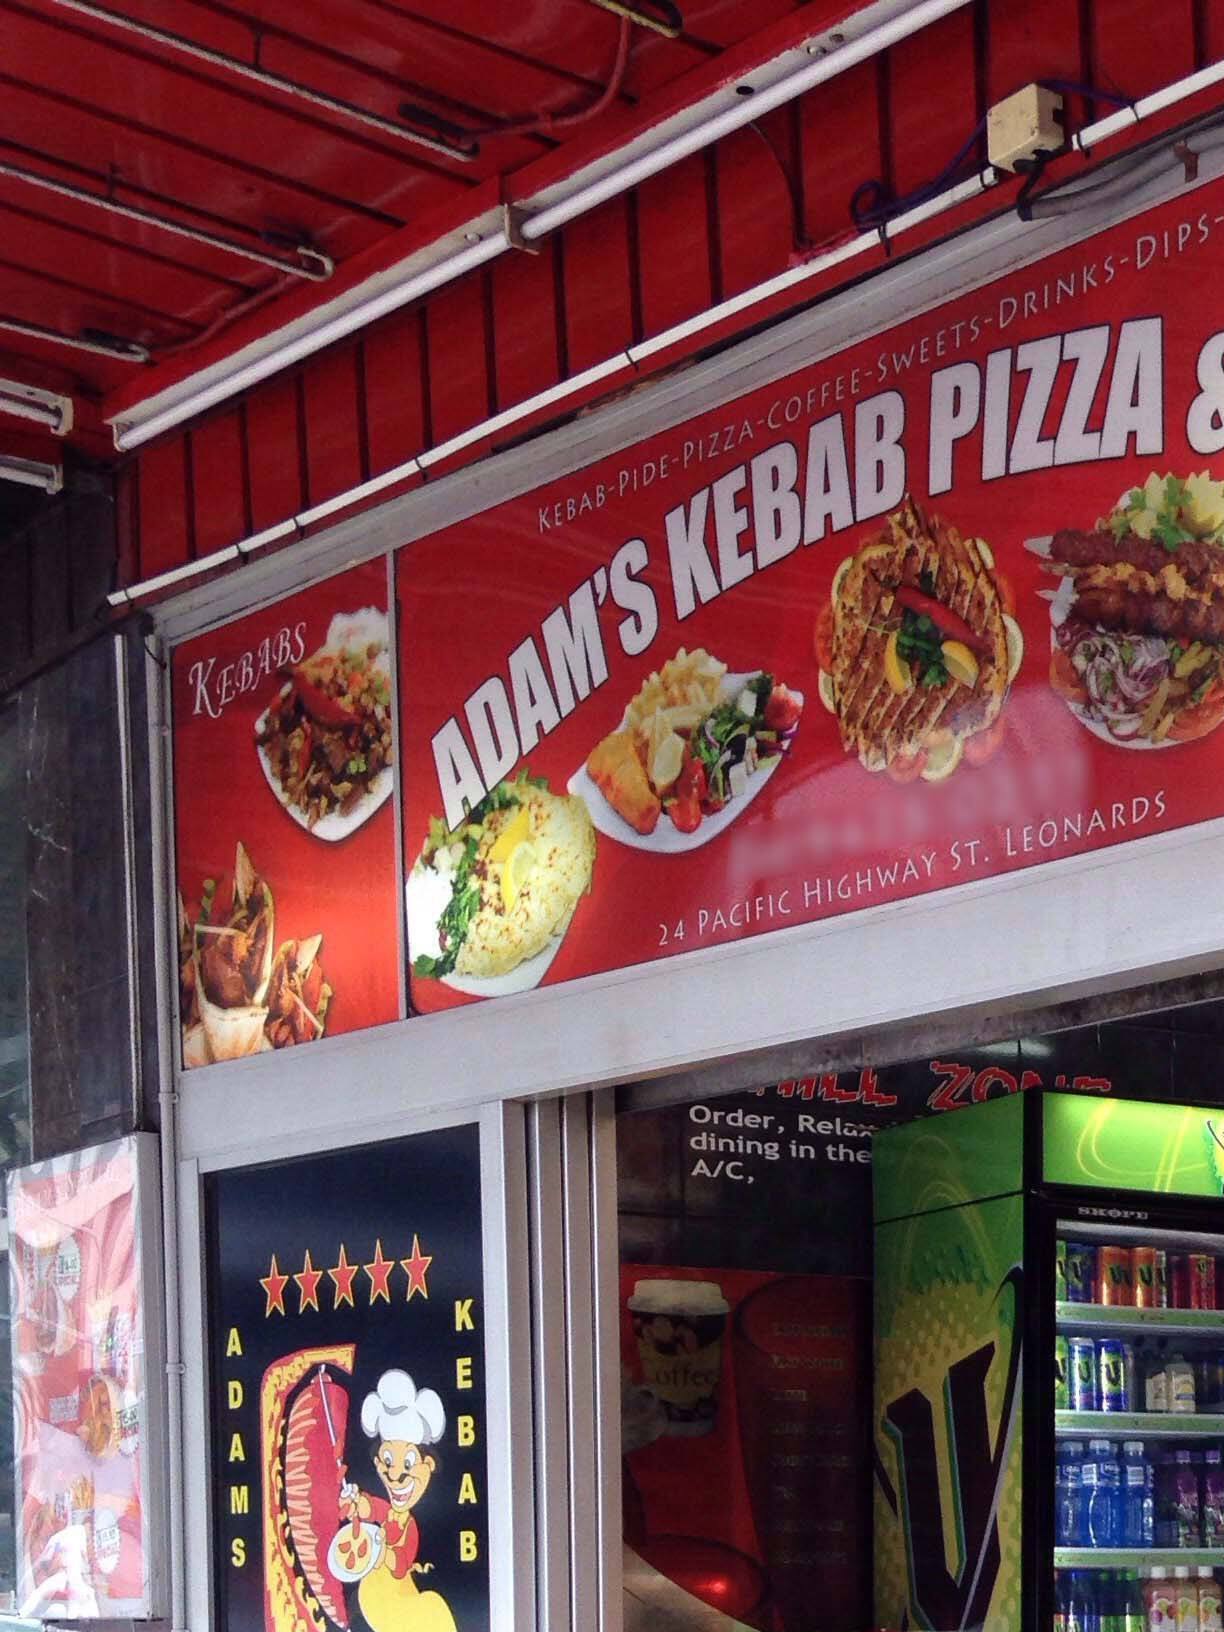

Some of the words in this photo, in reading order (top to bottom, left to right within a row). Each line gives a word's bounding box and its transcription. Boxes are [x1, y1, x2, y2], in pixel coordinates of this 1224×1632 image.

[430, 538, 659, 833] ADAM'S
[663, 388, 907, 620] KEBAB
[927, 315, 1165, 497] PIZZA
[188, 622, 306, 718] KEBABS
[657, 922, 686, 946] 24
[697, 889, 792, 937] PACIFIC
[803, 850, 938, 909] HIGHWAY
[950, 839, 989, 871] ST.
[1005, 790, 1167, 858] LEONARDS
[689, 1105, 785, 1134] Order,
[690, 1132, 780, 1160] dining
[789, 1140, 816, 1159] in
[826, 1143, 873, 1164] the
[691, 1159, 755, 1184] A/C,
[225, 1327, 249, 1568] ADAMS
[454, 1299, 479, 1562] KEBAB
